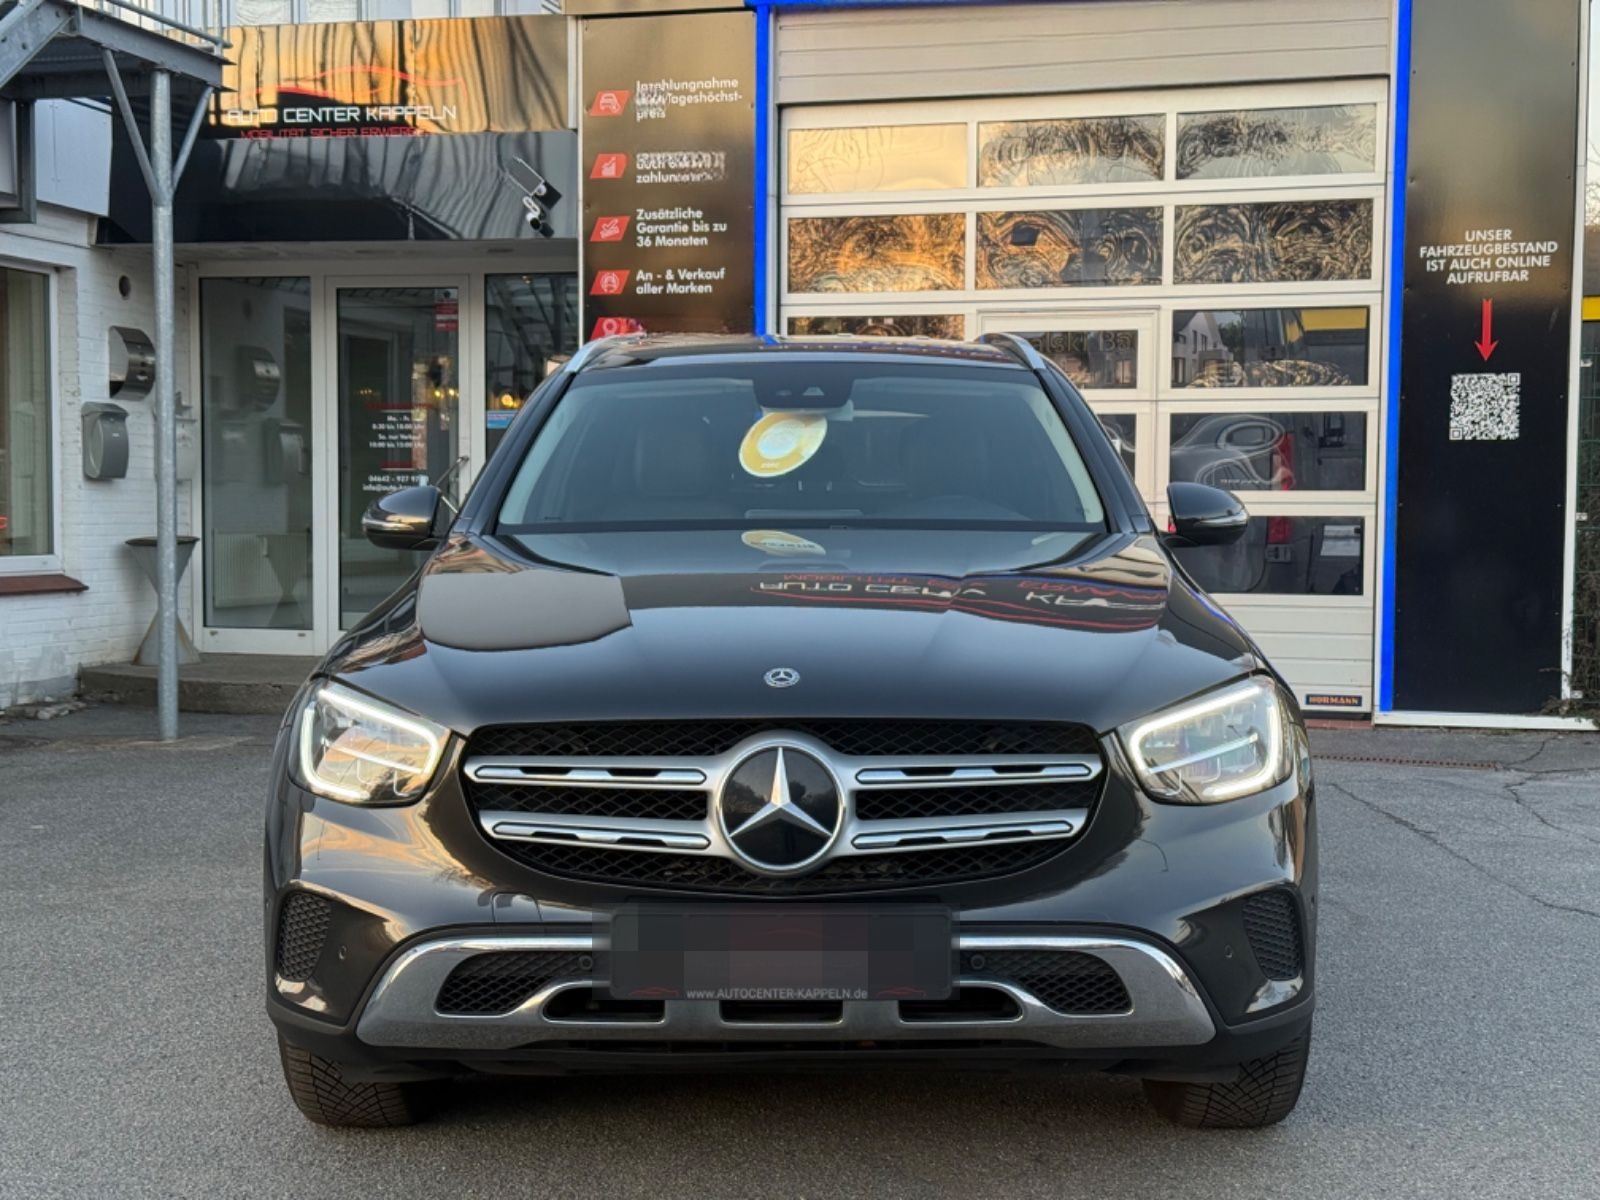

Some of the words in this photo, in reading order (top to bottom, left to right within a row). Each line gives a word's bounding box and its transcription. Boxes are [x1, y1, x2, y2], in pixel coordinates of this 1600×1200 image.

[228, 109, 278, 123] AUTO
[284, 107, 360, 122] CENTER
[366, 106, 457, 122] KAPPELN
[361, 126, 430, 137] ERWERB
[636, 206, 703, 221] Zusätzliche
[636, 221, 689, 234] Garantie
[692, 220, 710, 233] bis
[712, 222, 728, 232] zu
[636, 236, 652, 247] 36
[655, 235, 708, 247] Monaten
[1465, 229, 1512, 241] UNSER
[1420, 241, 1558, 258] FAHRZEUGBESTAND
[1426, 259, 1445, 271] IST
[1450, 257, 1491, 270] AUCH
[1496, 255, 1551, 268] ONLINE
[636, 269, 653, 281] An
[665, 269, 675, 280] &
[677, 267, 726, 280] Verkauf
[1447, 269, 1529, 284] AUFRUFBAR
[636, 282, 664, 294] aller
[666, 281, 713, 294] Marken
[686, 988, 868, 999] www.AUTOCENTER-KAPPELN.de
